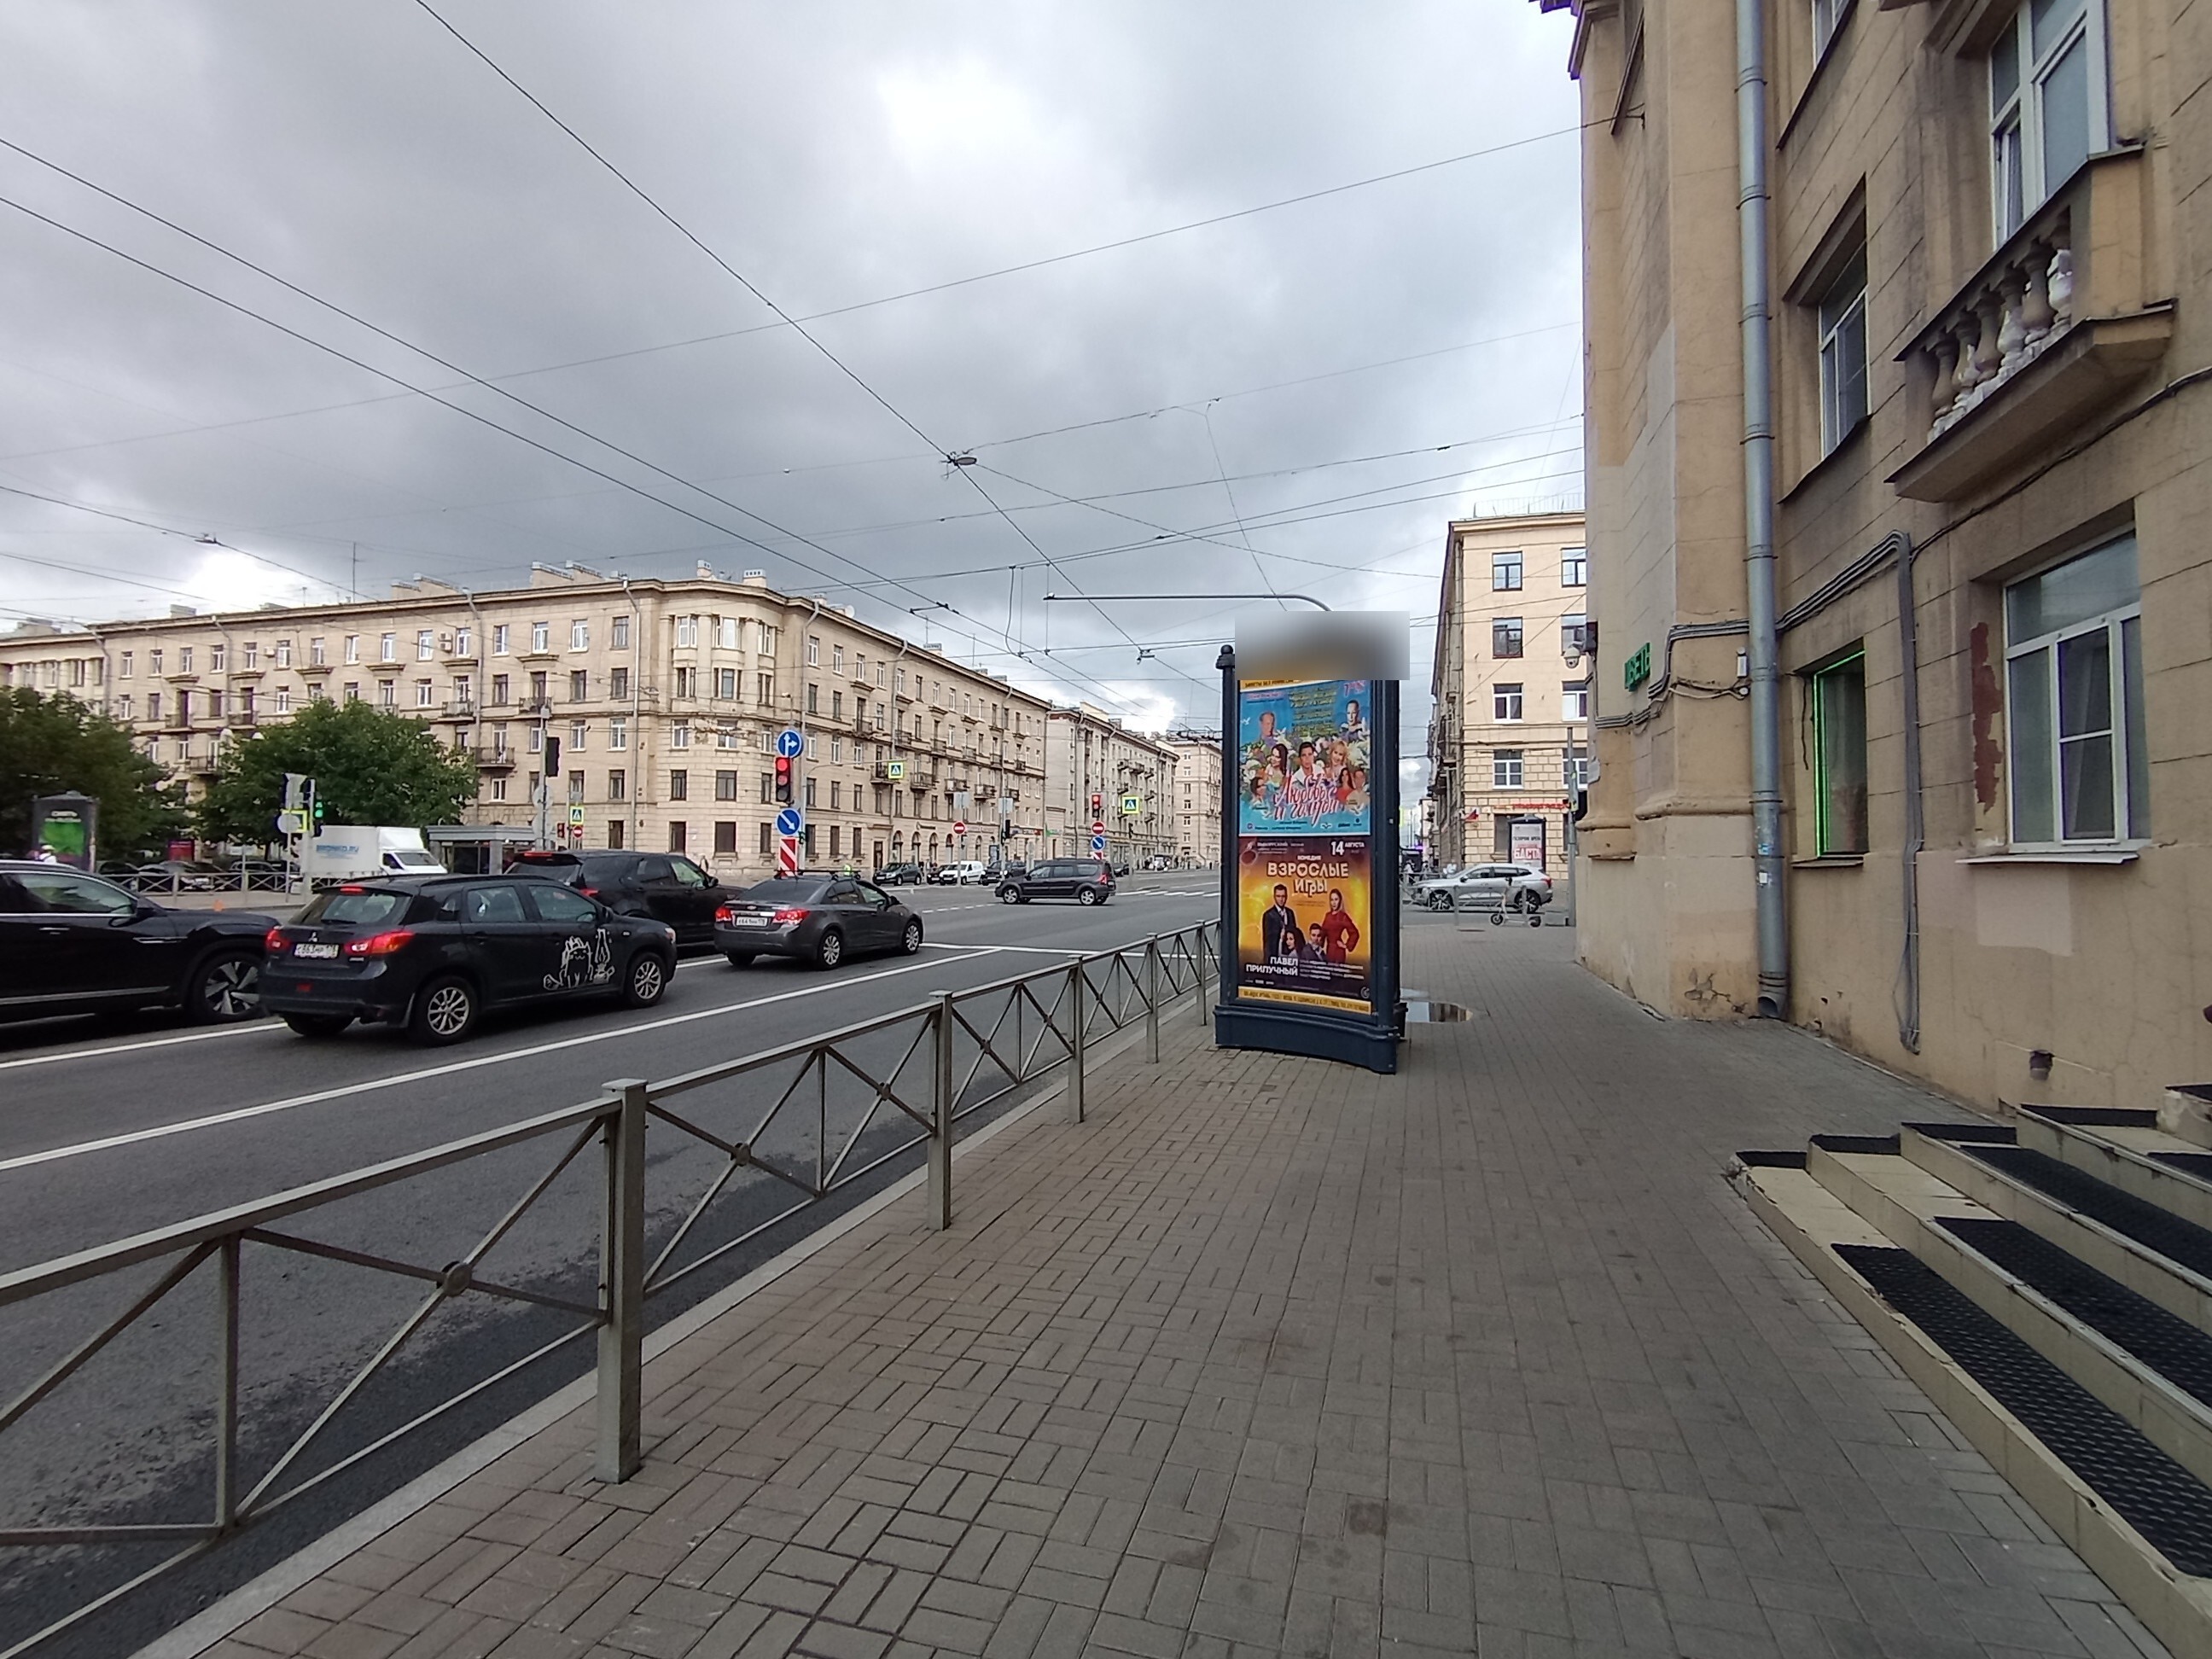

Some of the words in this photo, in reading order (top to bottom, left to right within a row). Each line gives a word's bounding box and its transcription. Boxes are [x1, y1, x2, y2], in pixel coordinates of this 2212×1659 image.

[1331, 841, 1345, 855] 14
[1267, 862, 1349, 877] ВЗРОСЛЫЕ
[1270, 957, 1299, 966] ПАВЕЛ
[1246, 963, 1299, 976] ПРИЛУЧНЫЙ
